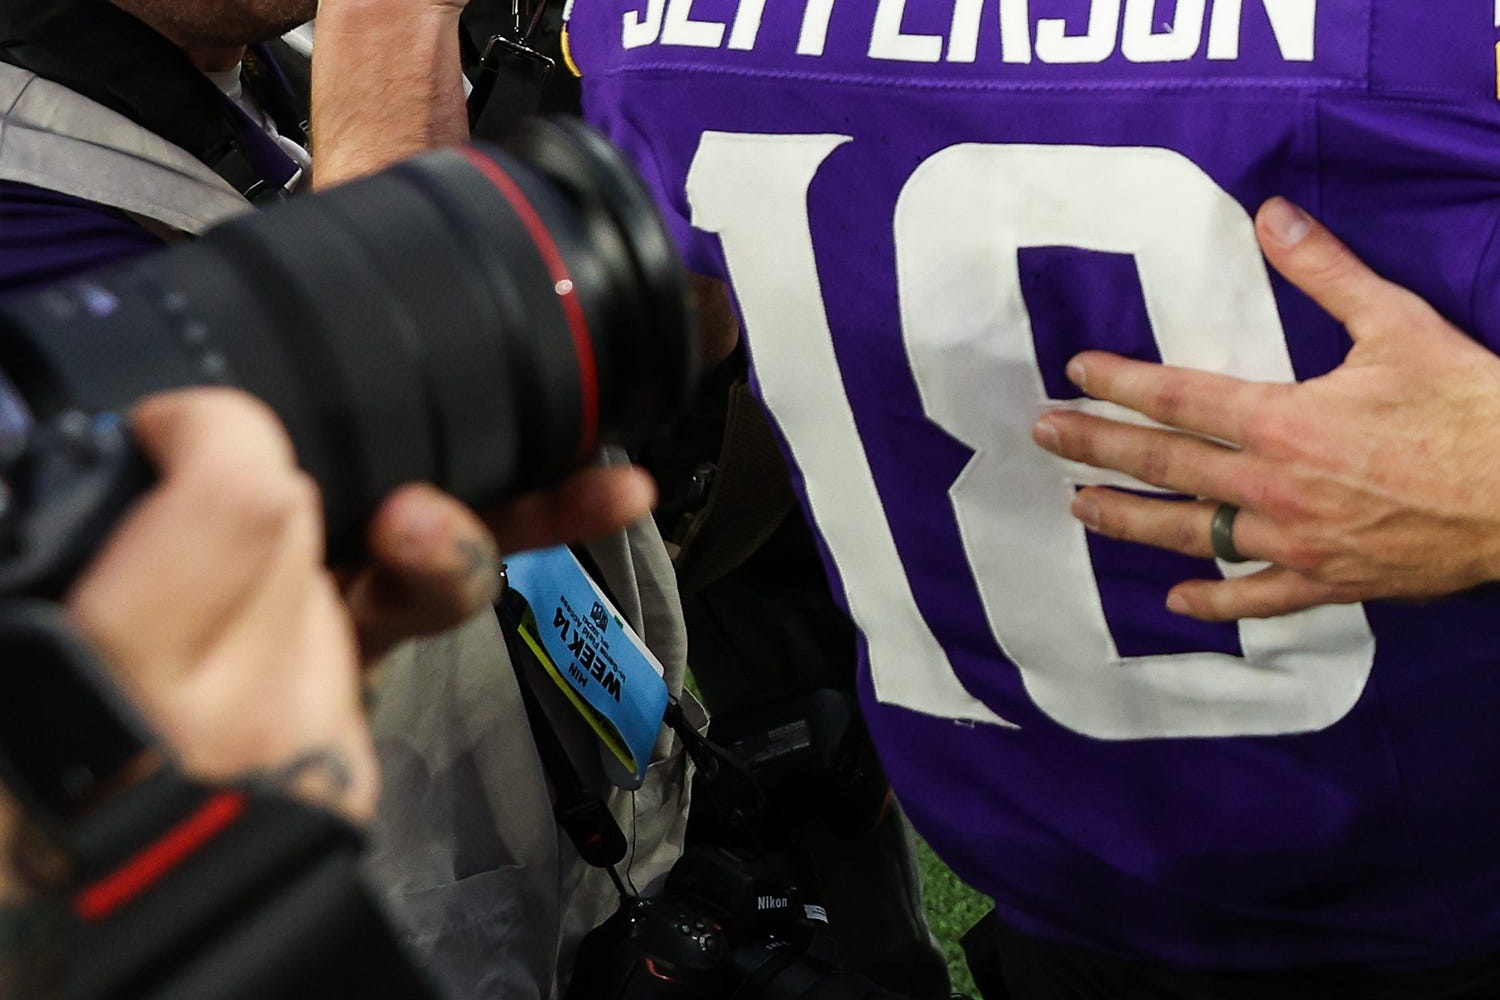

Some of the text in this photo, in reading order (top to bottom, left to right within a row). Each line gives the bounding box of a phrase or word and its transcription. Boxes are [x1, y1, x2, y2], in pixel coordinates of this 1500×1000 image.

[686, 130, 1376, 741] 18
[552, 607, 570, 642] 14
[567, 631, 621, 703] WEEK
[568, 662, 589, 688] MIN
[757, 896, 788, 910] Nikon
